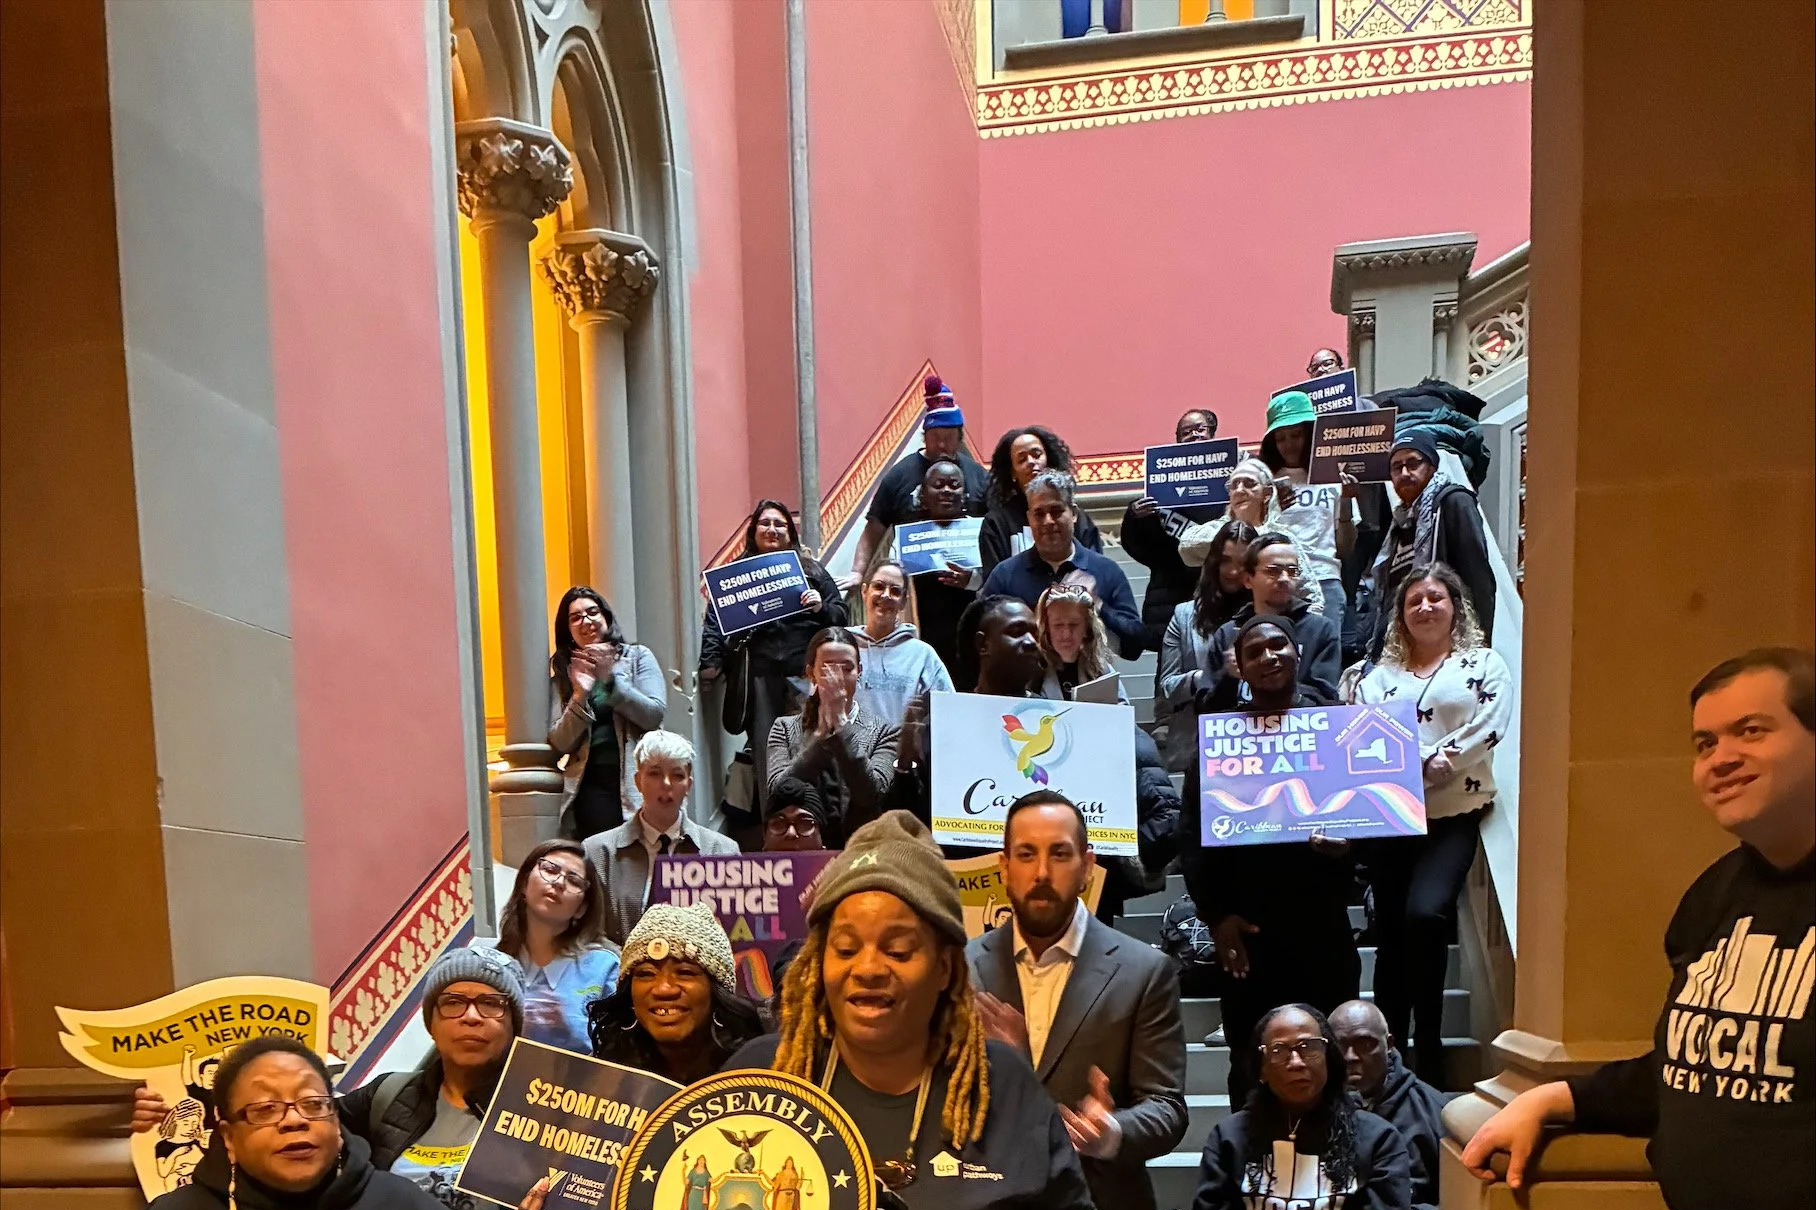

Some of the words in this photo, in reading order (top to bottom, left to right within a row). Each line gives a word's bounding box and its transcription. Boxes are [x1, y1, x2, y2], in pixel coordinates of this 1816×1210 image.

[1325, 384, 1346, 396] HAVP
[1314, 396, 1353, 414] LESSNESS
[1323, 427, 1350, 441] $250M
[1350, 426, 1364, 438] FOR
[1365, 425, 1386, 437] HAVP
[1156, 458, 1187, 470] $250M
[1187, 455, 1204, 466] FOR
[1205, 452, 1228, 463] HAVP
[1315, 446, 1331, 457] END
[1332, 442, 1391, 456] HOMELESSNESS
[1149, 474, 1167, 484] END
[1168, 467, 1235, 482] HOMELESSNESS
[719, 573, 751, 591] $250M
[751, 569, 770, 582] FOR
[769, 563, 792, 576] HAVP
[717, 594, 736, 608] END
[736, 576, 804, 602] HOMELESSNESS
[1205, 711, 1330, 738] HOUSING
[1204, 733, 1316, 758] JUSTICE
[1206, 756, 1264, 778] FOR
[1269, 753, 1325, 774] ALL
[935, 820, 987, 830] ADVOCATING
[988, 823, 1005, 832] FOR
[1087, 830, 1108, 838] OICES
[661, 858, 794, 888] HOUSING
[729, 915, 787, 942] ALL
[112, 1023, 183, 1053] MAKE
[185, 1004, 235, 1033] THE
[241, 1003, 311, 1026] ROAD
[205, 1025, 252, 1047] NEW
[1666, 1008, 1795, 1078] VOCAL
[1662, 1063, 1707, 1094] NEW
[1715, 1075, 1795, 1103] YORK
[525, 1077, 597, 1120] $250M
[594, 1098, 631, 1127] FOR
[673, 1090, 834, 1145] ASSEMBLY
[494, 1110, 540, 1143] END
[539, 1124, 630, 1169] HOMELESS
[441, 1149, 466, 1159] THE
[566, 1183, 577, 1192] of
[573, 1185, 603, 1199] America
[571, 1173, 606, 1190] Volunteers
